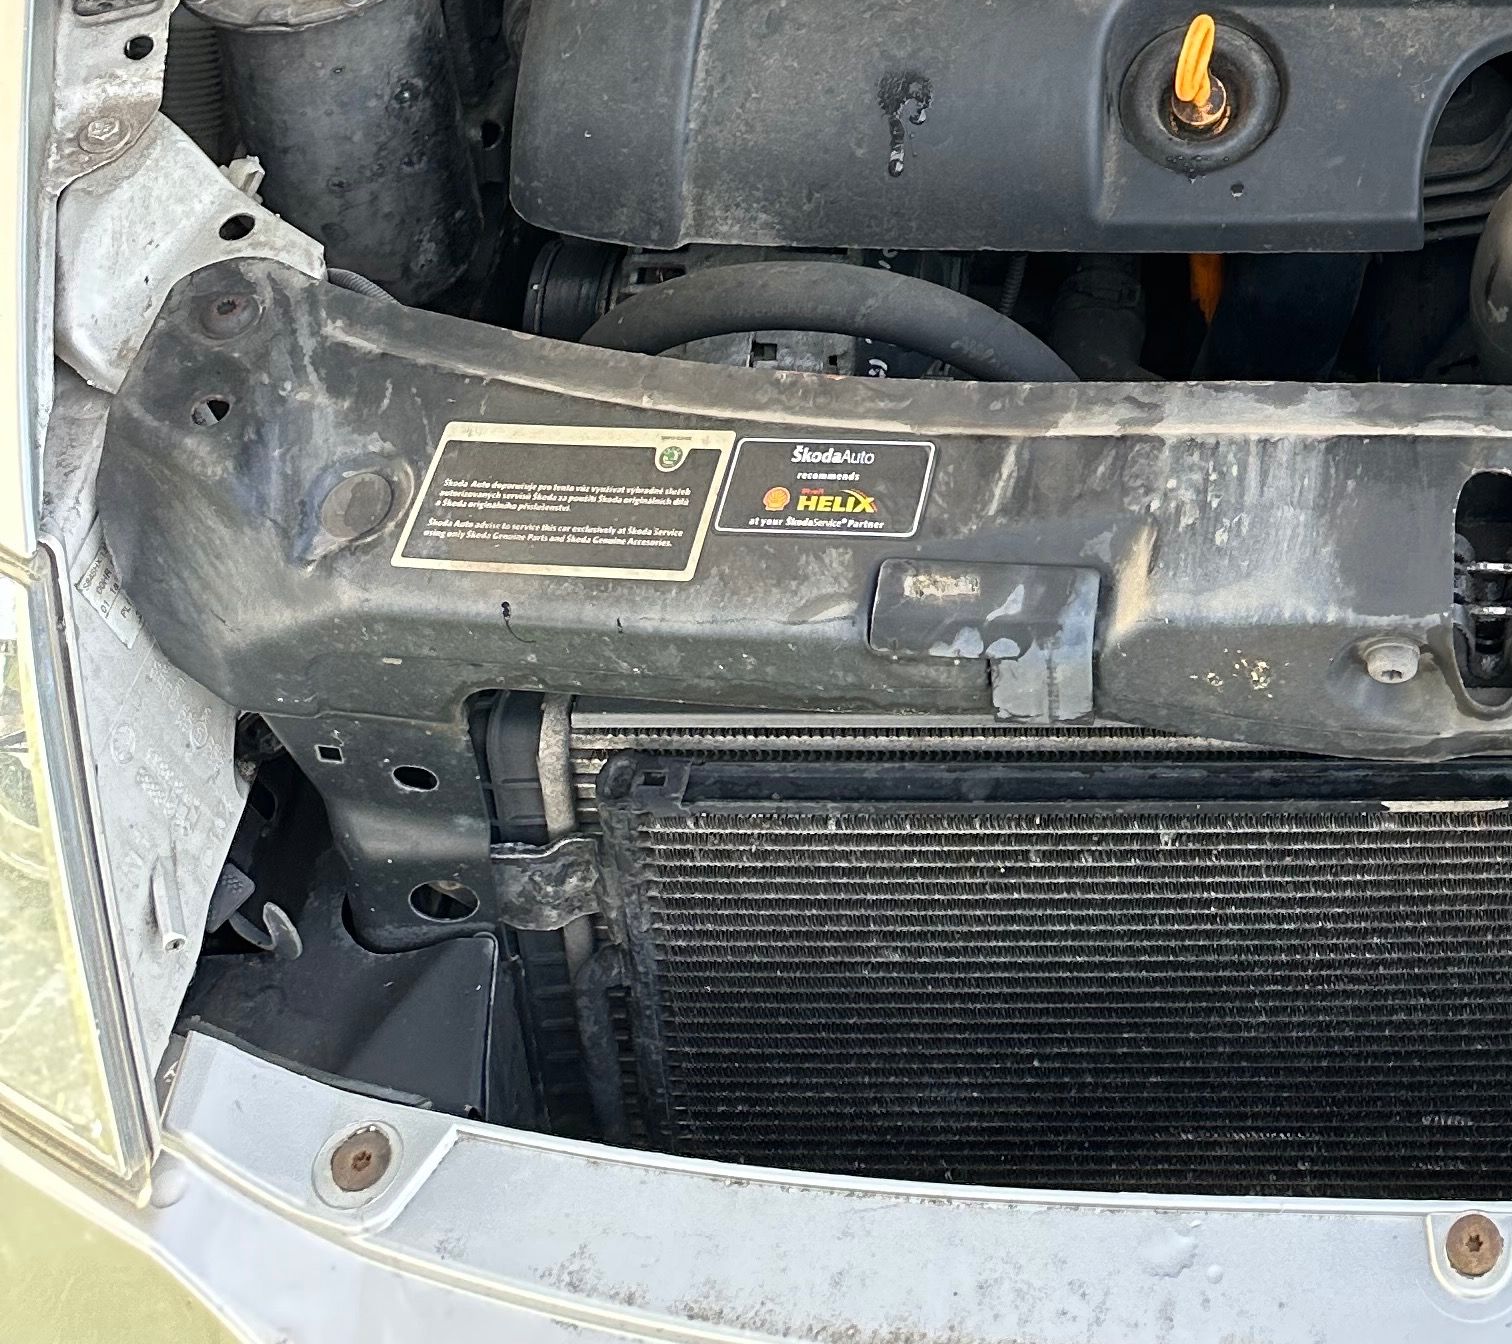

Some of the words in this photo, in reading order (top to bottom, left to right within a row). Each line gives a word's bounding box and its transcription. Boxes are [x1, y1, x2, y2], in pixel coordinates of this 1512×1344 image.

[791, 444, 875, 465] ŠkodaAuto
[797, 471, 860, 481] recommends
[443, 478, 468, 488] Škoda
[470, 480, 490, 489] Auto
[441, 498, 467, 507] Škoda
[532, 491, 556, 501] Škoda
[598, 494, 622, 504] Škoda
[796, 494, 877, 513] HELIX
[427, 517, 453, 527] Škoda
[453, 519, 474, 528] Auto
[475, 520, 500, 530] advise
[502, 522, 511, 530] to
[511, 523, 541, 531] service
[541, 523, 557, 532] this
[571, 524, 616, 535] exclusively
[617, 526, 627, 534] at
[627, 525, 652, 536] Škoda
[749, 517, 760, 526] at
[760, 518, 783, 527] your
[847, 519, 885, 529] Partner
[423, 529, 445, 539] using
[447, 530, 465, 540] only
[466, 529, 491, 539] Škoda
[492, 532, 526, 541] Genuine
[527, 533, 548, 542] Parts
[549, 534, 566, 543] and
[566, 533, 591, 544] Škoda
[592, 535, 626, 545] Genuine
